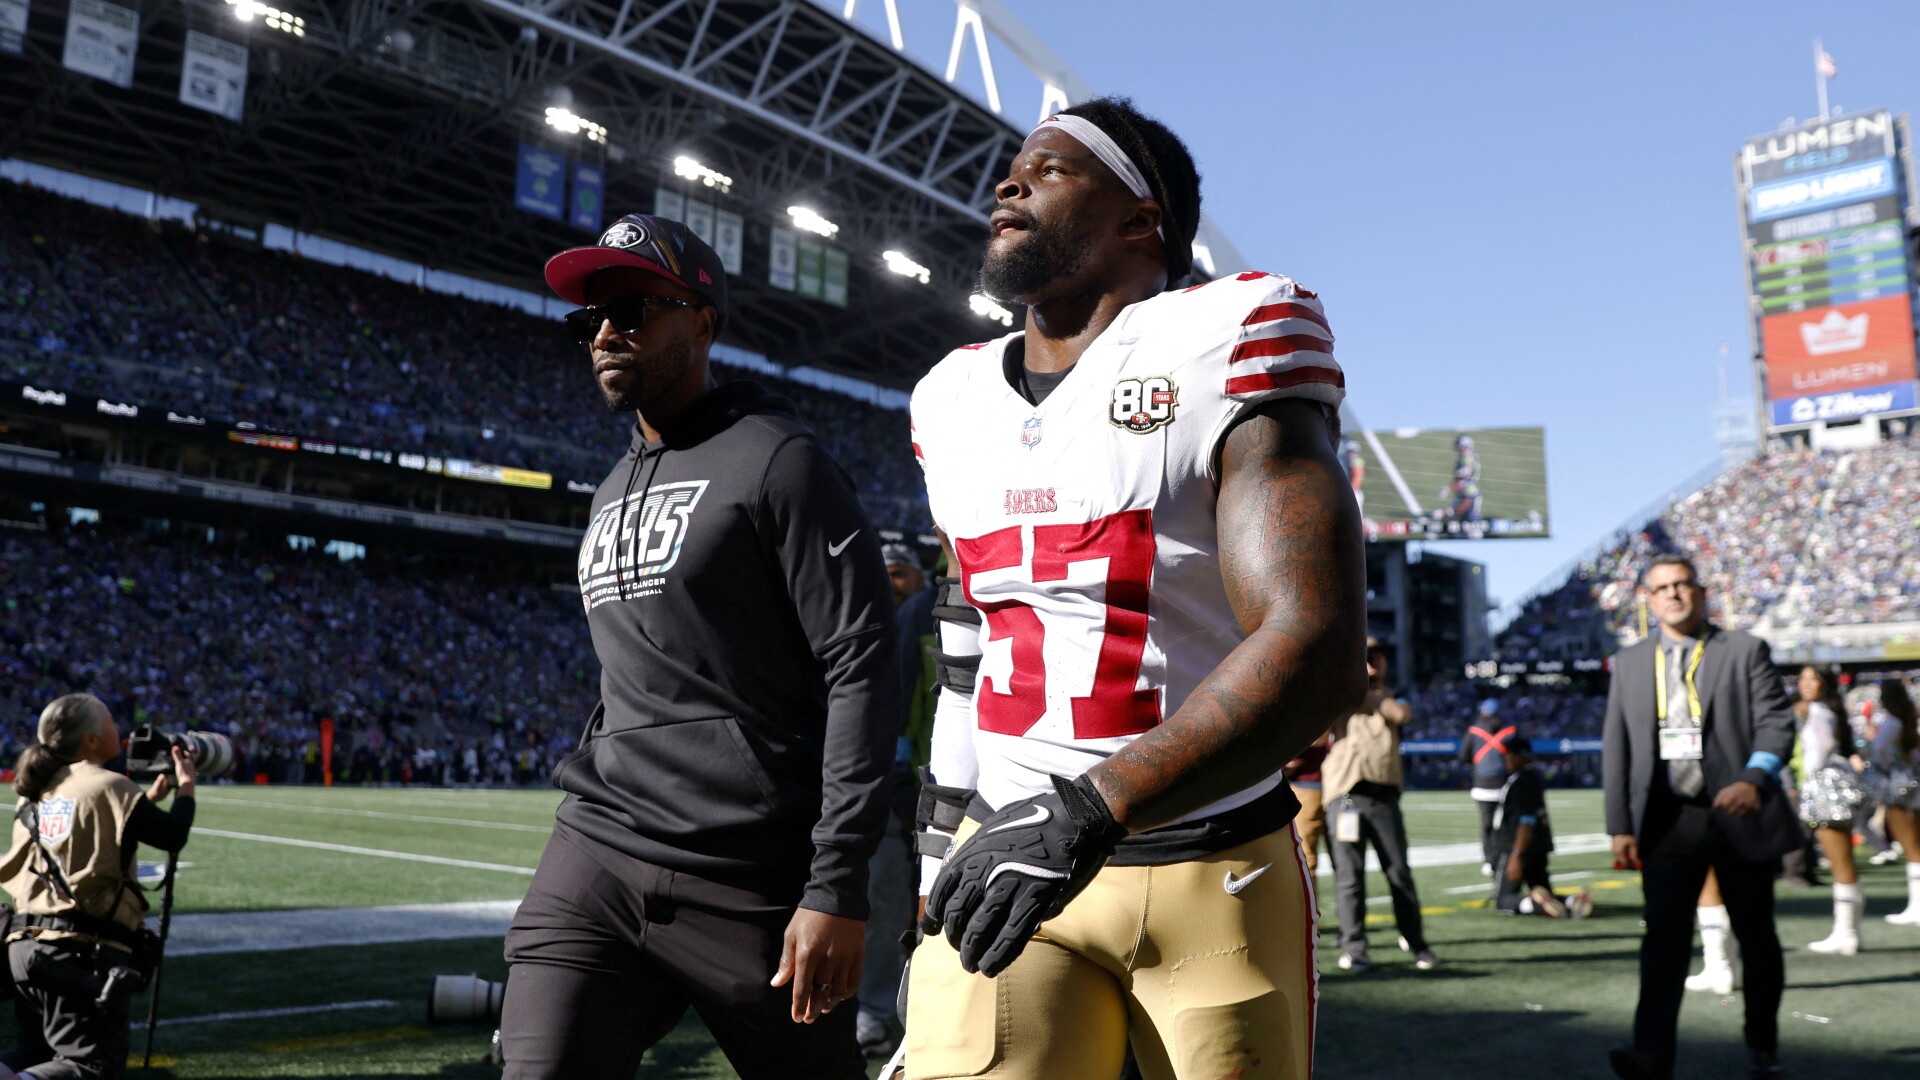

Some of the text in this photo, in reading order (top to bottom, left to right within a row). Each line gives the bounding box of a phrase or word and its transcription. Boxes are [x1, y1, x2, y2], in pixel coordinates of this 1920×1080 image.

[1742, 113, 1886, 165] LUMEN
[1784, 146, 1849, 172] FIELD
[1792, 361, 1888, 390] LUMEN
[1155, 393, 1170, 401] YEARS
[1815, 391, 1894, 418] Zillow
[1003, 487, 1058, 515] 49ERS
[632, 577, 666, 590] CANCER
[633, 588, 663, 599] FOOTBALL
[955, 508, 1163, 740] 57
[39, 815, 66, 838] NFL
